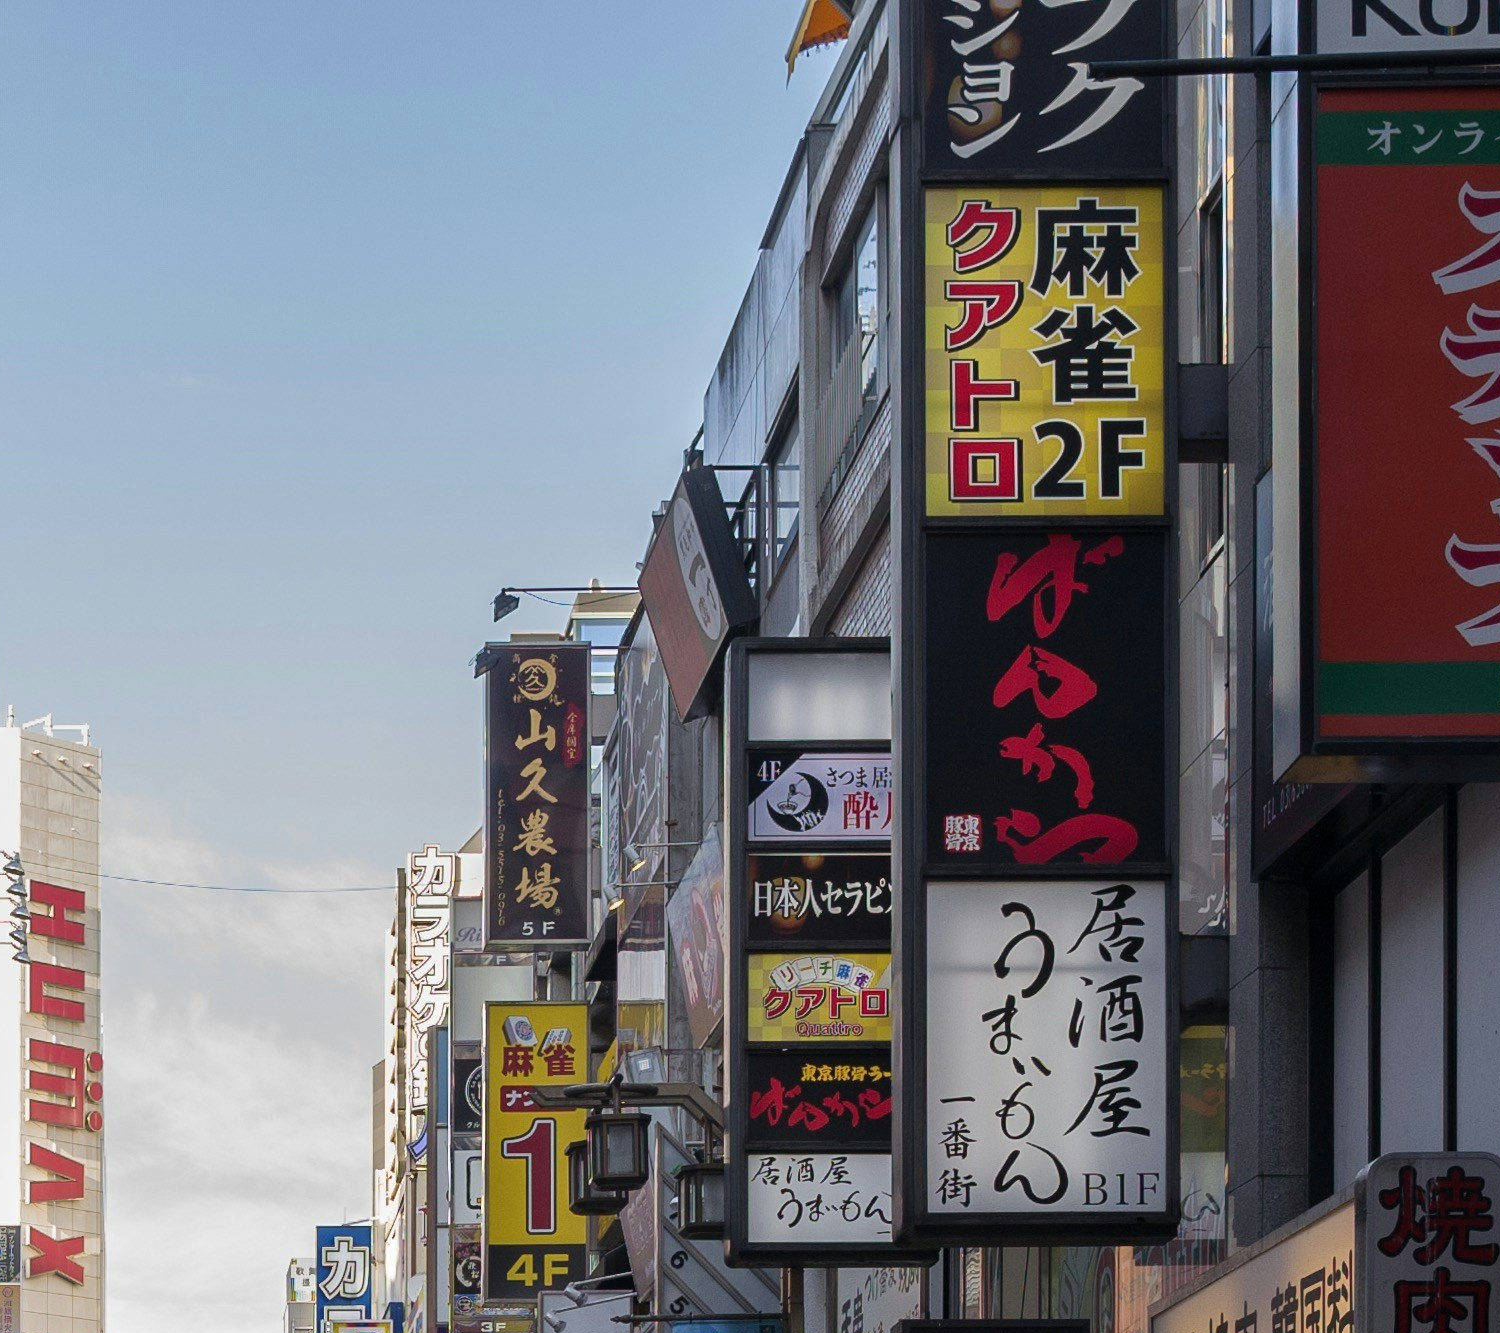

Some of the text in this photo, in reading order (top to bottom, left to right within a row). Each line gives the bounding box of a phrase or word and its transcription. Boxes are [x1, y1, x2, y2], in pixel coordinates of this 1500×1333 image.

[1028, 197, 1143, 405] 麻雀
[945, 200, 1024, 503] クアトロ
[1031, 418, 1148, 500] 2F
[757, 760, 782, 782] 4F
[825, 765, 869, 788] さつま
[513, 706, 562, 912] 山久農場
[521, 921, 556, 936] 5F
[763, 987, 888, 1019] クアトロ
[1064, 885, 1152, 1139] 居酒屋
[795, 1020, 864, 1037] Quattro
[501, 1044, 577, 1079] 麻雀
[936, 1097, 978, 1208] 一番街
[751, 1156, 853, 1186] 居酒屋
[1083, 1172, 1161, 1206] B1F
[506, 1253, 570, 1287] 4F
